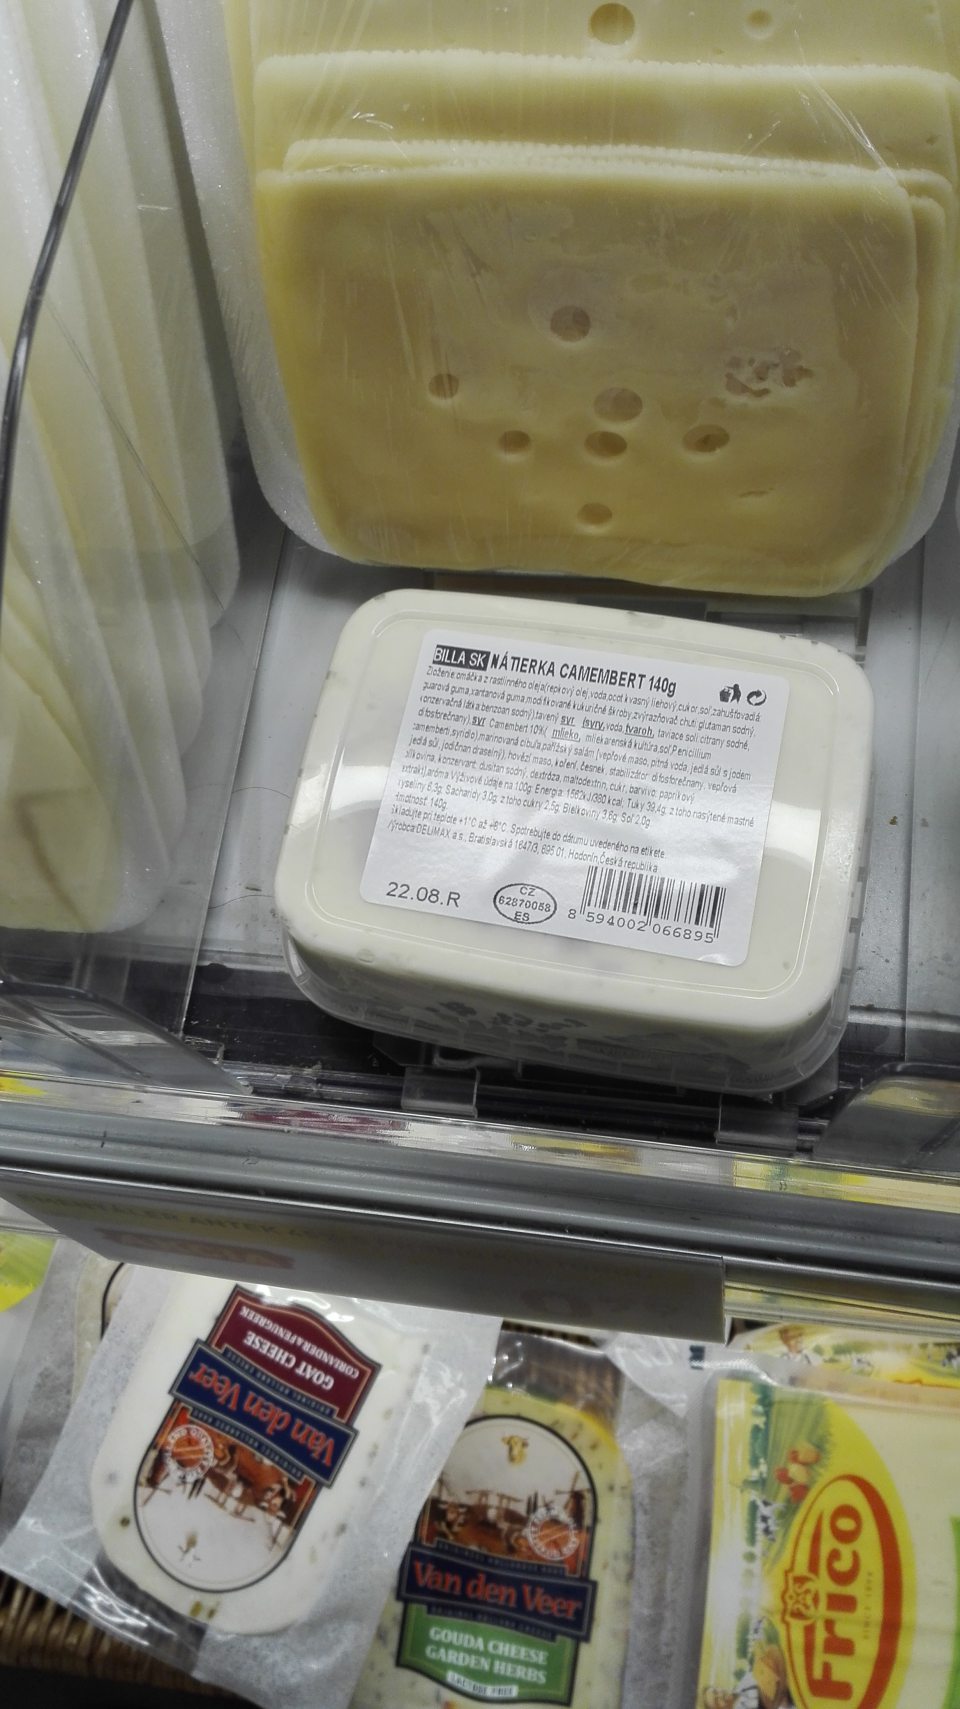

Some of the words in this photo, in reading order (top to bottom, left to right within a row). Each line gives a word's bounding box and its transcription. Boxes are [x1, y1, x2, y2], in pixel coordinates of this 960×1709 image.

[433, 647, 468, 665] BILLA
[468, 651, 487, 668] SK
[490, 650, 555, 677] NÁTIERKA
[559, 663, 646, 689] CAMEMBERT
[648, 675, 676, 698] 140g
[489, 676, 527, 689] rastlinného
[572, 700, 607, 715] kukuričné
[489, 717, 528, 733] Camembert
[585, 733, 632, 749] mliekarenská
[560, 715, 576, 727] syr
[657, 728, 684, 741] taviace
[507, 749, 532, 762] hovězí
[532, 756, 553, 767] maso,
[708, 779, 736, 793] vepřová
[574, 746, 594, 757] salám
[627, 756, 649, 767] maso,
[650, 758, 668, 769] pitná
[689, 762, 708, 775] jedlá
[710, 765, 721, 776] sůl
[727, 768, 751, 780] jodem
[445, 784, 480, 801] Sacharidy
[506, 795, 521, 806] toho
[522, 798, 543, 811] cukry
[479, 761, 504, 773] dusitan
[530, 768, 561, 783] dextróza,
[563, 775, 607, 791] maltodextrin,
[658, 790, 695, 805] paprikový
[483, 776, 503, 790] údaje
[504, 781, 513, 790] na
[627, 798, 645, 812] Tuky
[675, 807, 691, 818] toho
[692, 810, 726, 823] nasýtené
[727, 816, 754, 827] mastné
[422, 811, 433, 821] pri
[433, 810, 457, 824] teplote
[478, 819, 487, 829] až
[510, 823, 550, 841] Spotrebujte
[552, 831, 561, 841] do
[562, 832, 588, 846] dátumu
[589, 839, 629, 853] uvedeného
[629, 845, 639, 854] na
[468, 832, 513, 848] Bratislavská
[385, 881, 461, 908] 22.08.R
[498, 895, 551, 912] 62870058
[518, 885, 537, 898] CZ
[513, 910, 531, 922] ES
[567, 908, 577, 919] 8
[585, 911, 647, 932] 594002
[652, 923, 715, 943] 066895
[243, 1330, 297, 1372] CHEESE
[189, 1362, 242, 1412] Veer
[295, 1365, 335, 1391] GOAT
[243, 1391, 292, 1437] den
[291, 1418, 335, 1468] Van
[413, 1557, 462, 1595] Van
[465, 1572, 516, 1607] den
[521, 1583, 583, 1620] Veer
[803, 1503, 864, 1702] Frico
[425, 1645, 490, 1673] GARDEN
[493, 1660, 547, 1684] HERBS
[428, 1626, 484, 1652] GOUDA
[487, 1640, 549, 1666] CHEESE
